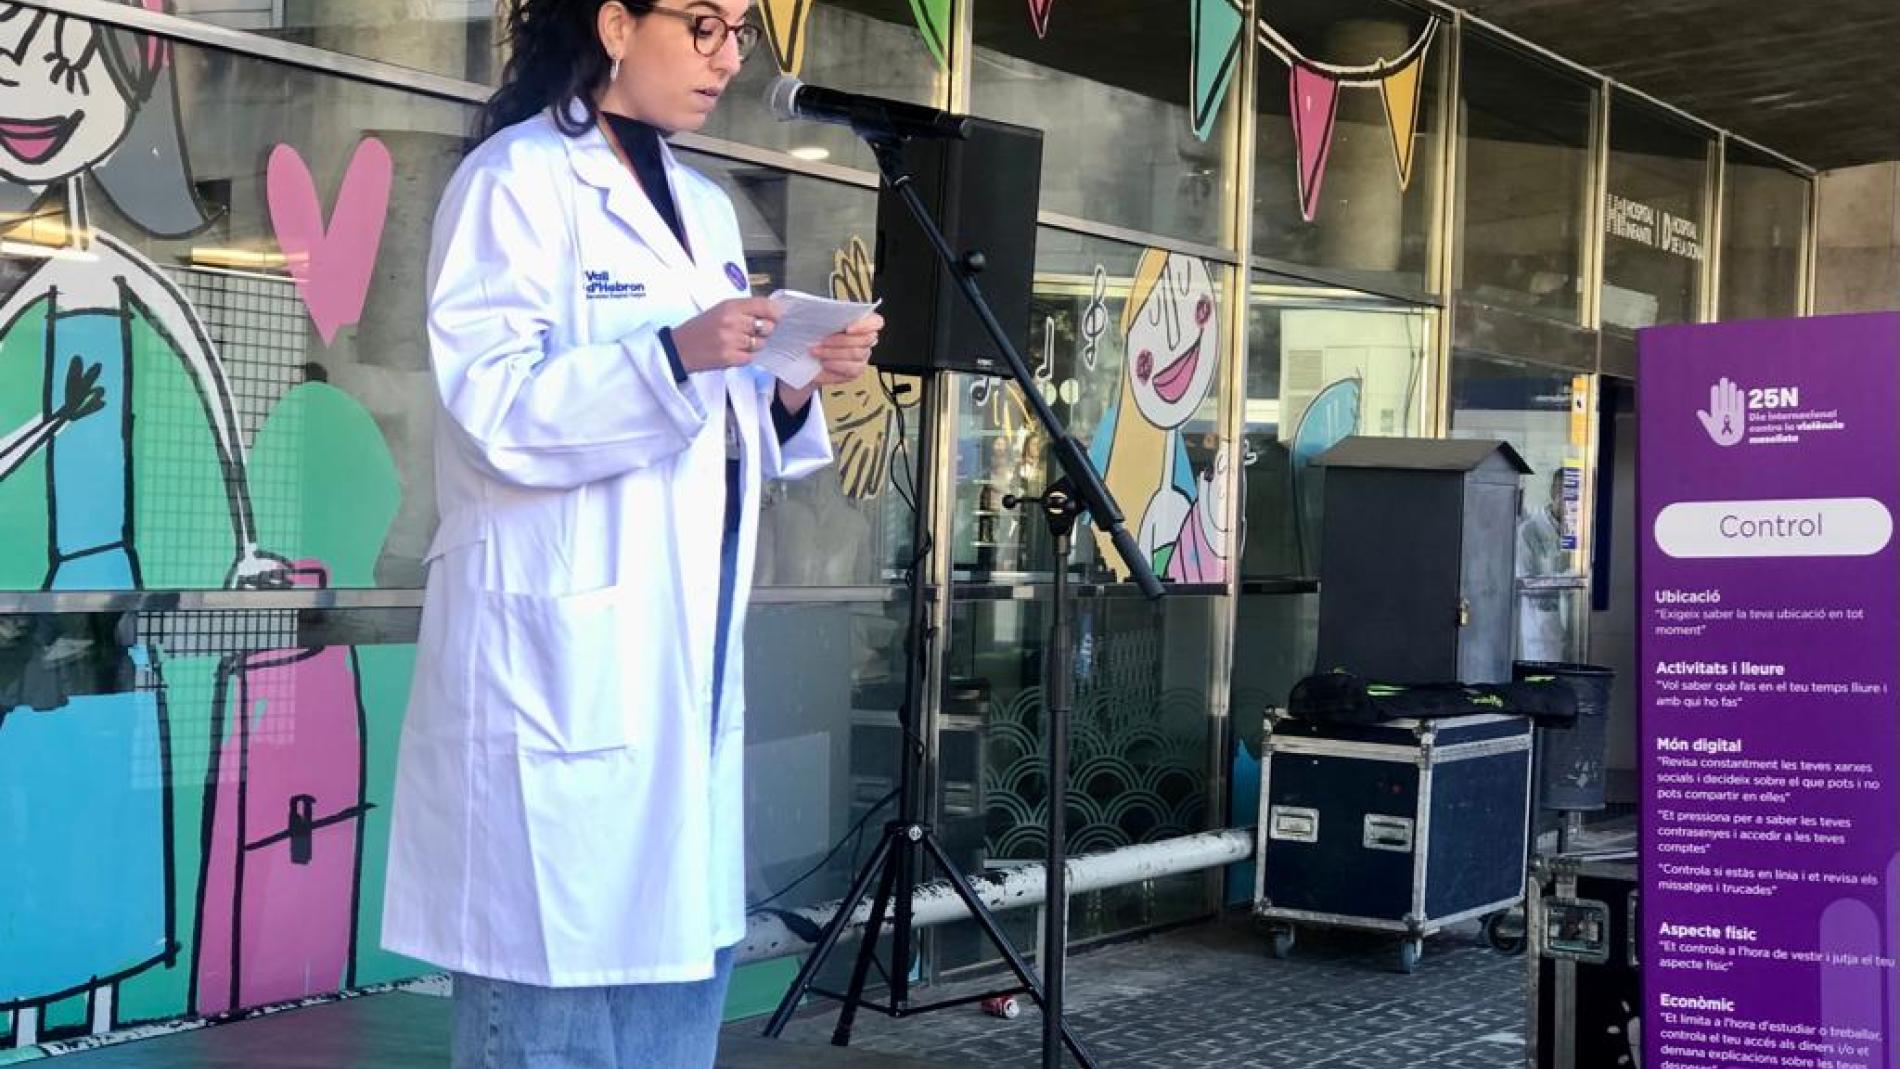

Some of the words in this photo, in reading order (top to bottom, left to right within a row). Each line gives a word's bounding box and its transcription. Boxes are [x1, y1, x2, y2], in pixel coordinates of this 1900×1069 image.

[1749, 387, 1798, 408] 25N
[1785, 422, 1795, 431] la
[1720, 512, 1823, 538] Control
[1655, 590, 1720, 603] Ubicació
[1703, 609, 1733, 619] saber
[1736, 609, 1747, 619] la
[1750, 609, 1773, 619] teva
[1778, 608, 1825, 619] ubicació
[1829, 610, 1843, 619] en
[1846, 609, 1863, 619] tot
[1656, 662, 1728, 675] Activitats
[1741, 662, 1785, 676] lleure
[1682, 681, 1712, 690] saber
[1740, 681, 1756, 691] fas
[1759, 683, 1773, 692] en
[1777, 681, 1786, 692] el
[1790, 683, 1807, 692] teu
[1811, 683, 1848, 694] temps
[1852, 683, 1880, 693] lliure
[1656, 696, 1681, 706] amb
[1684, 696, 1701, 708] qui
[1704, 696, 1718, 706] ho
[1657, 737, 1688, 750] Món
[1693, 738, 1741, 753] digital
[1700, 758, 1778, 770] constantment
[1781, 760, 1796, 771] les
[1835, 764, 1872, 772] xarxes
[1657, 773, 1694, 784] socials
[1703, 774, 1750, 785] decideix
[1753, 776, 1786, 786] sobre
[1789, 777, 1799, 787] el
[1802, 779, 1824, 789] que
[1827, 779, 1854, 790] pots
[1864, 780, 1880, 789] no
[1657, 790, 1681, 801] pots
[1685, 790, 1739, 802] compartir
[1742, 792, 1757, 801] en
[1677, 811, 1730, 824] pressiona
[1733, 814, 1752, 825] per
[1755, 815, 1763, 824] a
[1766, 814, 1797, 825] saber
[1801, 815, 1817, 826] les
[1658, 827, 1730, 840] contrasenyes
[1740, 830, 1781, 841] accedir
[1785, 833, 1792, 841] a
[1794, 832, 1810, 842] les
[1714, 865, 1722, 876] si
[1758, 869, 1772, 878] en
[1809, 871, 1820, 881] et
[1823, 872, 1857, 884] revisa
[1861, 874, 1878, 885] els
[1659, 880, 1713, 893] missatges
[1659, 922, 1721, 938] Aspecte
[1679, 943, 1725, 955] controla
[1729, 947, 1735, 955] a
[1738, 946, 1770, 957] l'hora
[1772, 949, 1788, 959] de
[1792, 951, 1823, 961] vestir
[1832, 954, 1858, 966] jutja
[1862, 955, 1872, 965] el
[1876, 957, 1895, 967] teu
[1659, 957, 1702, 970] aspecte
[1660, 993, 1735, 1011] Econòmic
[1681, 1014, 1711, 1026] limita
[1714, 1018, 1721, 1026] a
[1724, 1017, 1755, 1029] l'hora
[1759, 1020, 1815, 1035] d'estudiar
[1820, 1027, 1826, 1035] o
[1660, 1029, 1706, 1042] controla
[1709, 1032, 1720, 1043] el
[1723, 1034, 1741, 1045] teu
[1744, 1035, 1776, 1049] accés
[1779, 1038, 1795, 1049] als
[1798, 1039, 1833, 1053] diners
[1857, 1047, 1869, 1056] et
[1660, 1045, 1706, 1058] demana
[1709, 1048, 1778, 1064] explicacions
[1781, 1054, 1813, 1066] sobre
[1817, 1057, 1832, 1069] les
